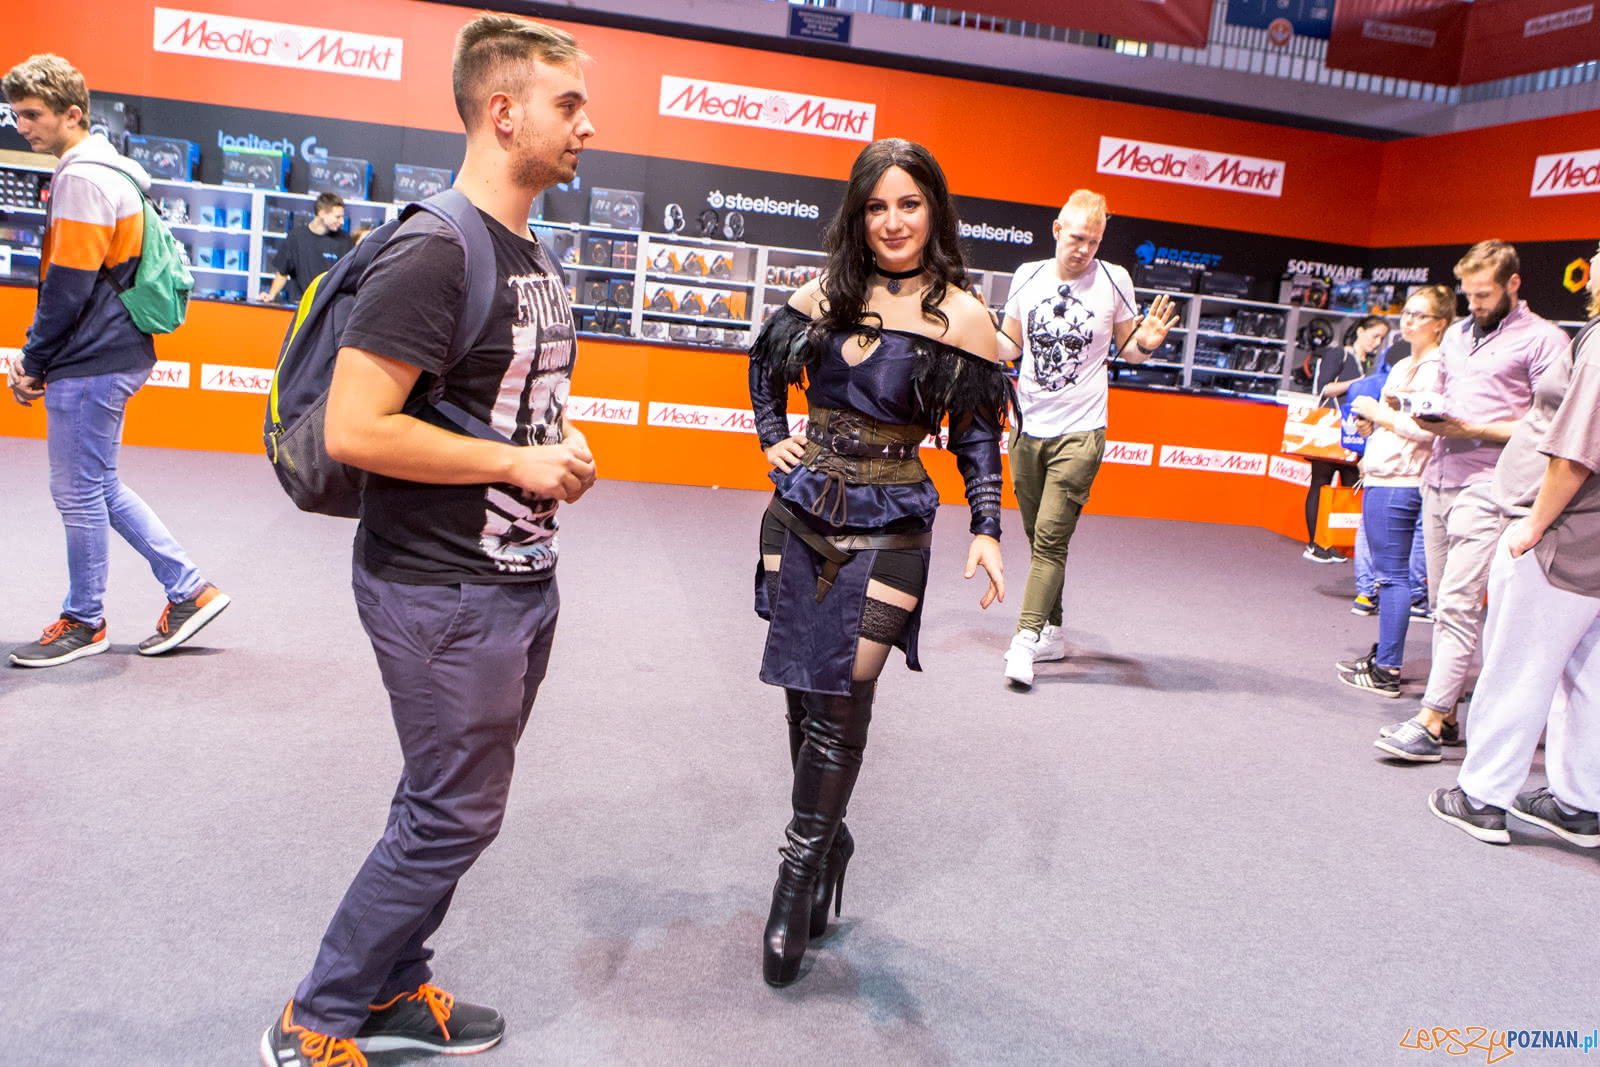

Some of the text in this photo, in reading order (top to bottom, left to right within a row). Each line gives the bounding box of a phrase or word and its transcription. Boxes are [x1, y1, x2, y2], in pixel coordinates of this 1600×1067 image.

[162, 18, 394, 71] Media Markt
[666, 84, 868, 134] Media Markt
[1103, 143, 1278, 190] Media Markt
[1536, 157, 1600, 191] Med
[725, 192, 819, 219] steelseries
[1288, 259, 1363, 282] SOFTWARE
[1372, 267, 1429, 282] SOFTWARE
[150, 367, 183, 383] arkt
[207, 369, 271, 389] Media
[582, 401, 633, 420] Markt
[653, 407, 709, 425] Media
[1104, 444, 1147, 461] Markt
[1164, 449, 1262, 472] Media Markt
